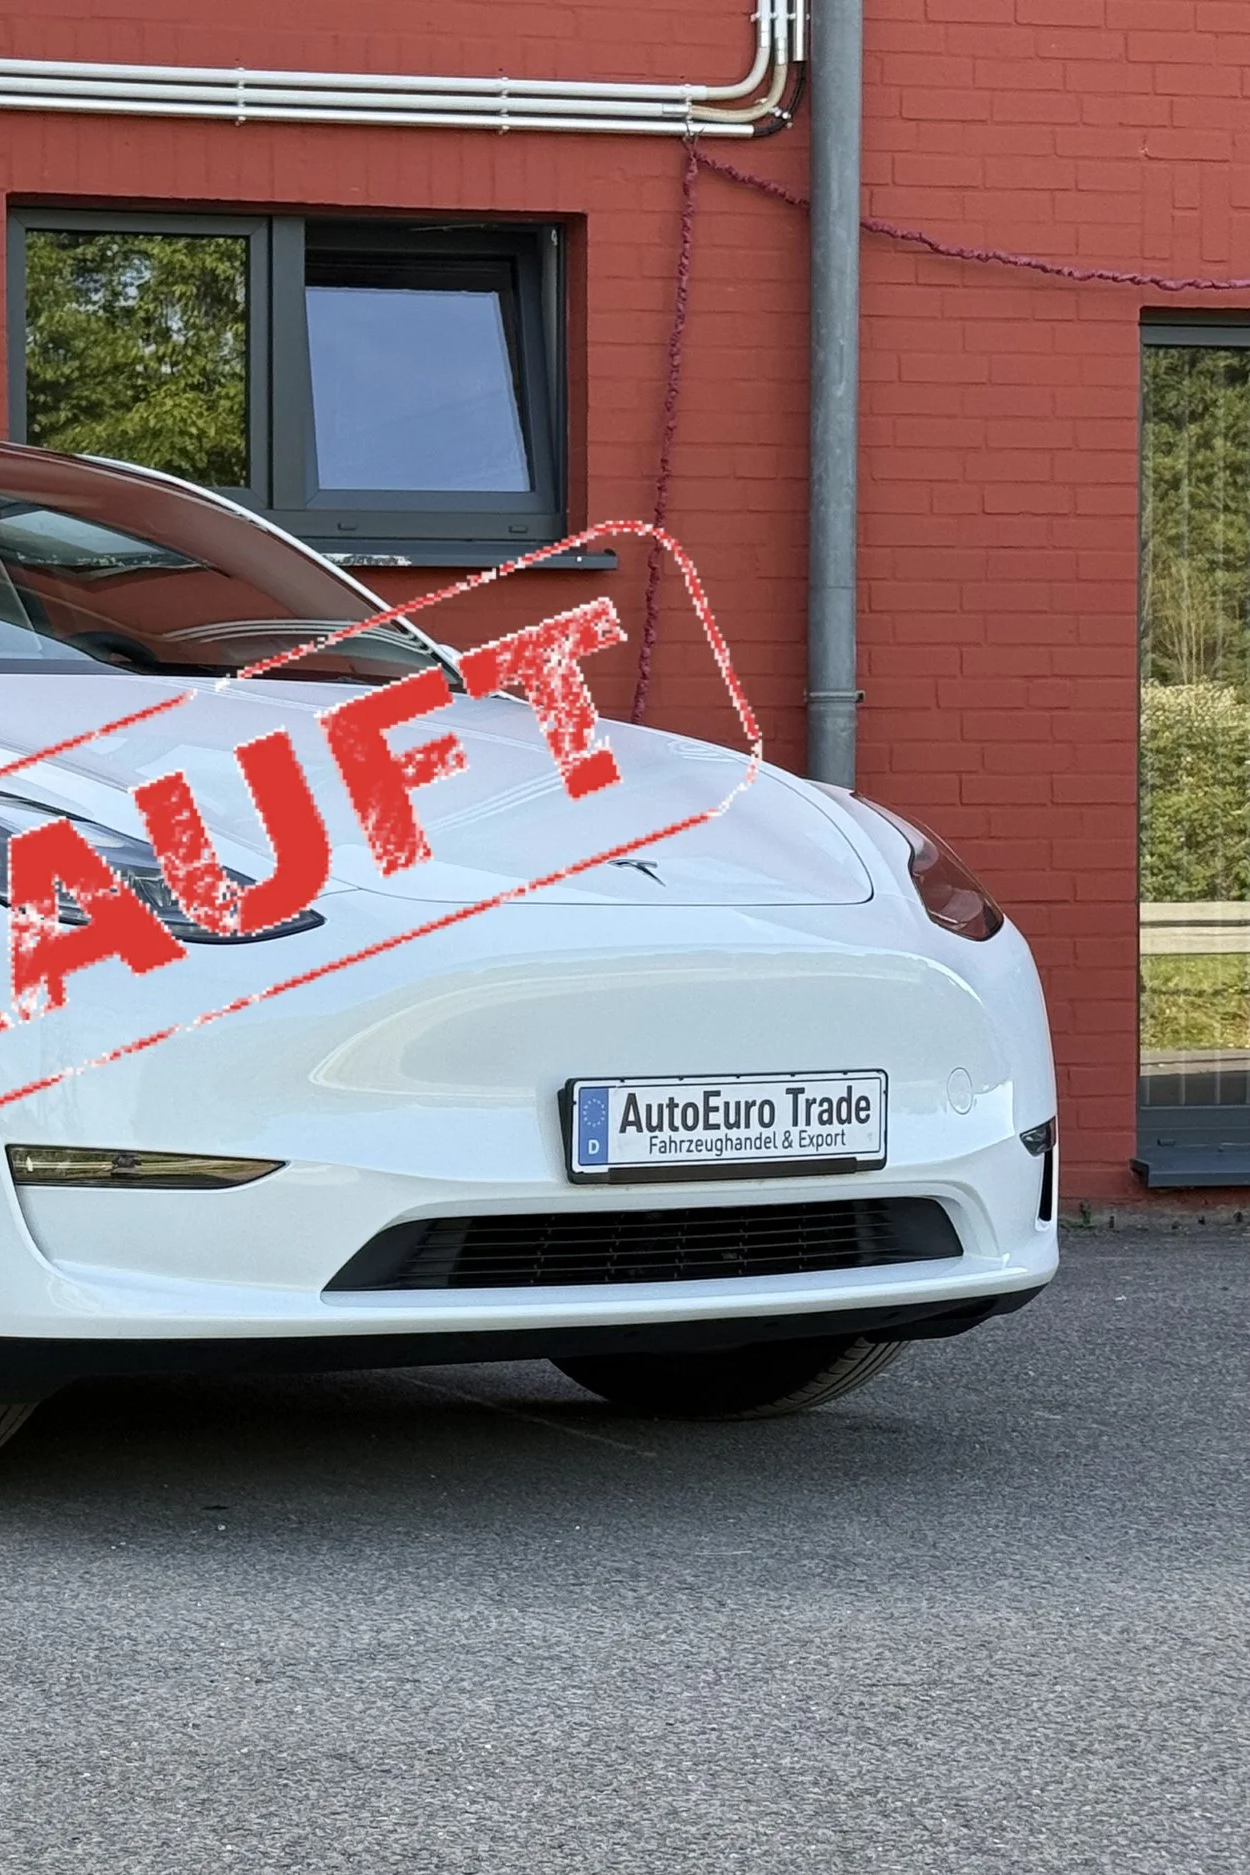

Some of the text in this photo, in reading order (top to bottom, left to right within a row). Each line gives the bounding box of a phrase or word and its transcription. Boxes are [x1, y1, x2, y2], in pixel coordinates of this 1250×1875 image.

[618, 1085, 871, 1134] AutoEuro Trade
[588, 1139, 600, 1155] D
[648, 1129, 847, 1157] Fahrzeughandel & Export
